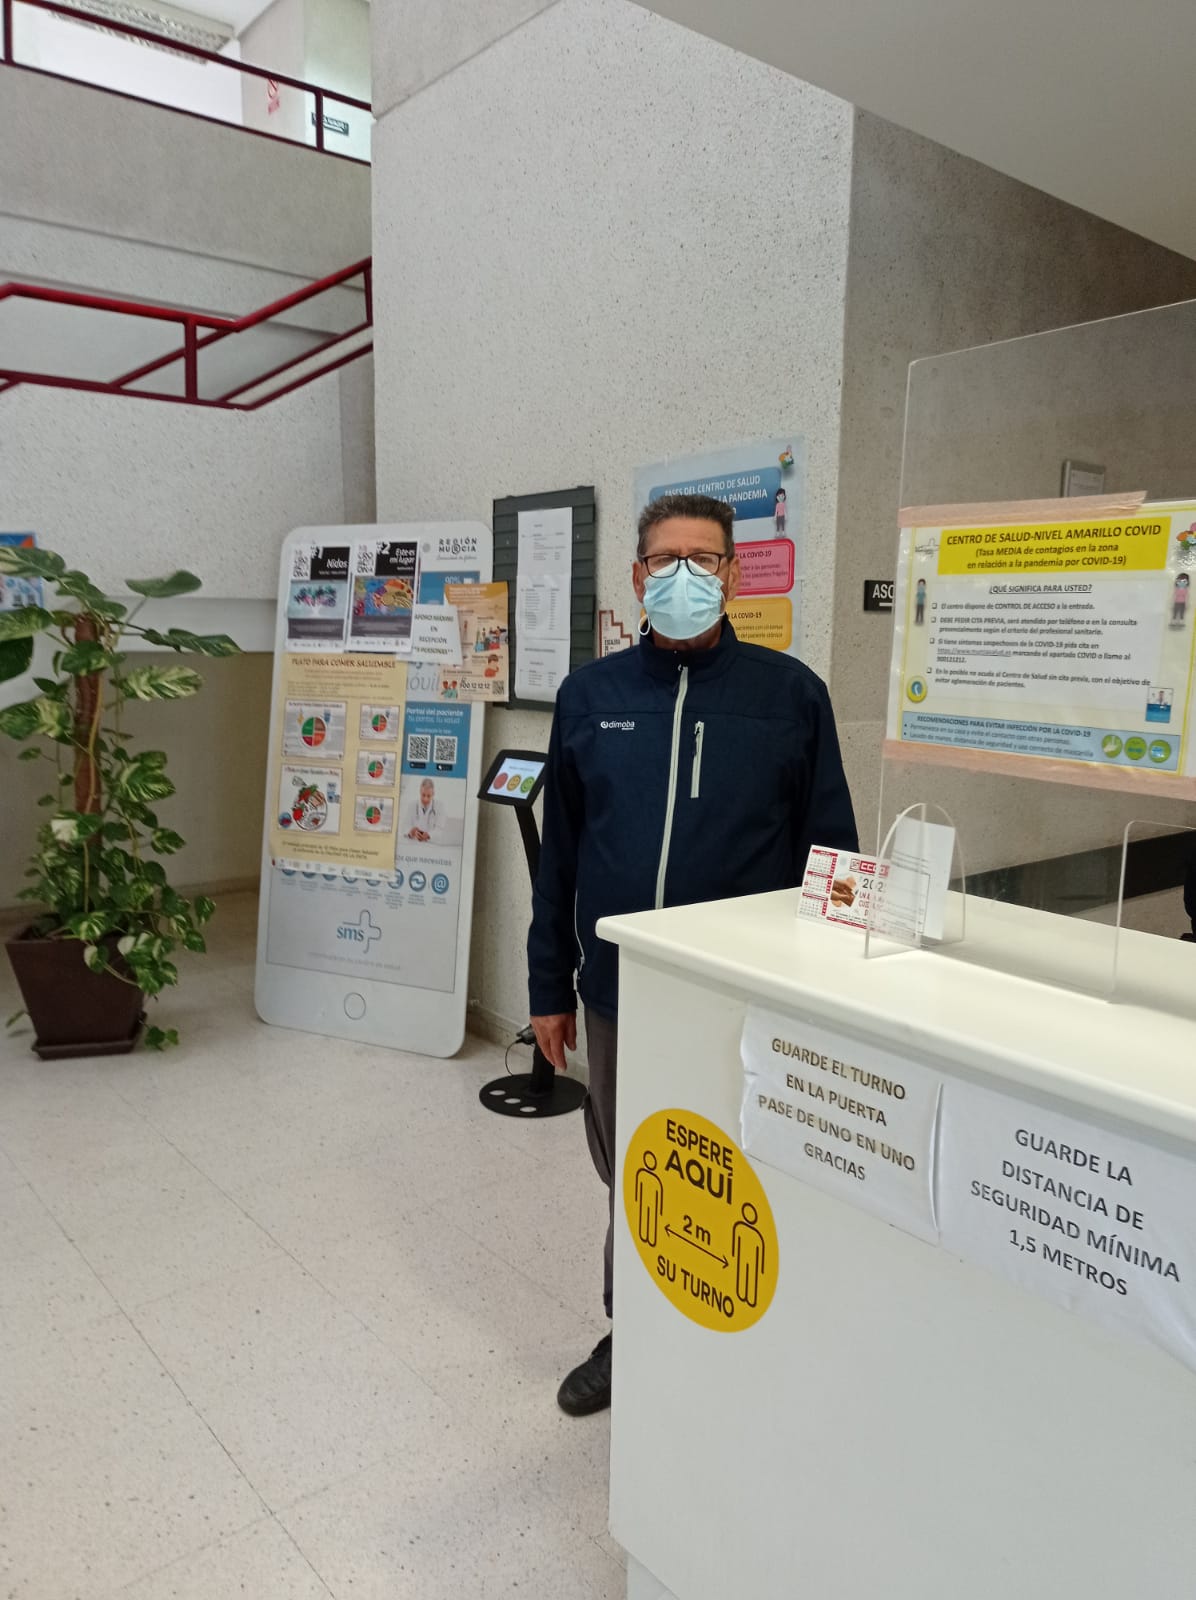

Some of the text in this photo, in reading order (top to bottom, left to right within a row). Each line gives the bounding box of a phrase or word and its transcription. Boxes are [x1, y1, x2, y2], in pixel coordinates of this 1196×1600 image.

[684, 486, 696, 494] DEL
[698, 481, 725, 493] CENTRO
[727, 480, 736, 488] DE
[737, 475, 760, 486] SALUD
[729, 489, 767, 502] PANDEMIA
[947, 525, 1161, 545] CENTRO DE SALUD-NIVEL AMARILLO COVID
[976, 548, 994, 557] (Tasa
[996, 547, 1022, 556] MEDIA
[1024, 546, 1033, 555] de
[1034, 544, 1074, 556] contagios
[1089, 544, 1096, 552] la
[978, 559, 1007, 568] relación
[1015, 559, 1022, 568] la
[1023, 557, 1063, 568] pandemia
[1065, 559, 1079, 568] por
[1082, 556, 1126, 566] COVID-19)
[989, 585, 1007, 594] ¿QUÉ
[1006, 723, 1037, 732] INFECCIÓN
[1039, 726, 1051, 734] POR
[337, 926, 364, 942] sms
[771, 1038, 906, 1100] GUARDE EL TURNO
[786, 1074, 887, 1126] EN LA PUERTA
[666, 1118, 733, 1171] ESPERE
[757, 1094, 916, 1172] PASE DE UNO EN UNO
[664, 1149, 733, 1205] AQUÍ
[804, 1141, 866, 1182] GRACIAS
[1015, 1128, 1133, 1186] GUARDE LA
[1002, 1160, 1145, 1231] DISTANCIA DE
[683, 1215, 711, 1246] 2 m
[970, 1180, 1181, 1283] SEGURIDAD MÍNIMA
[1010, 1228, 1128, 1296] 1,5 METROS
[657, 1254, 734, 1318] SU TURNO
